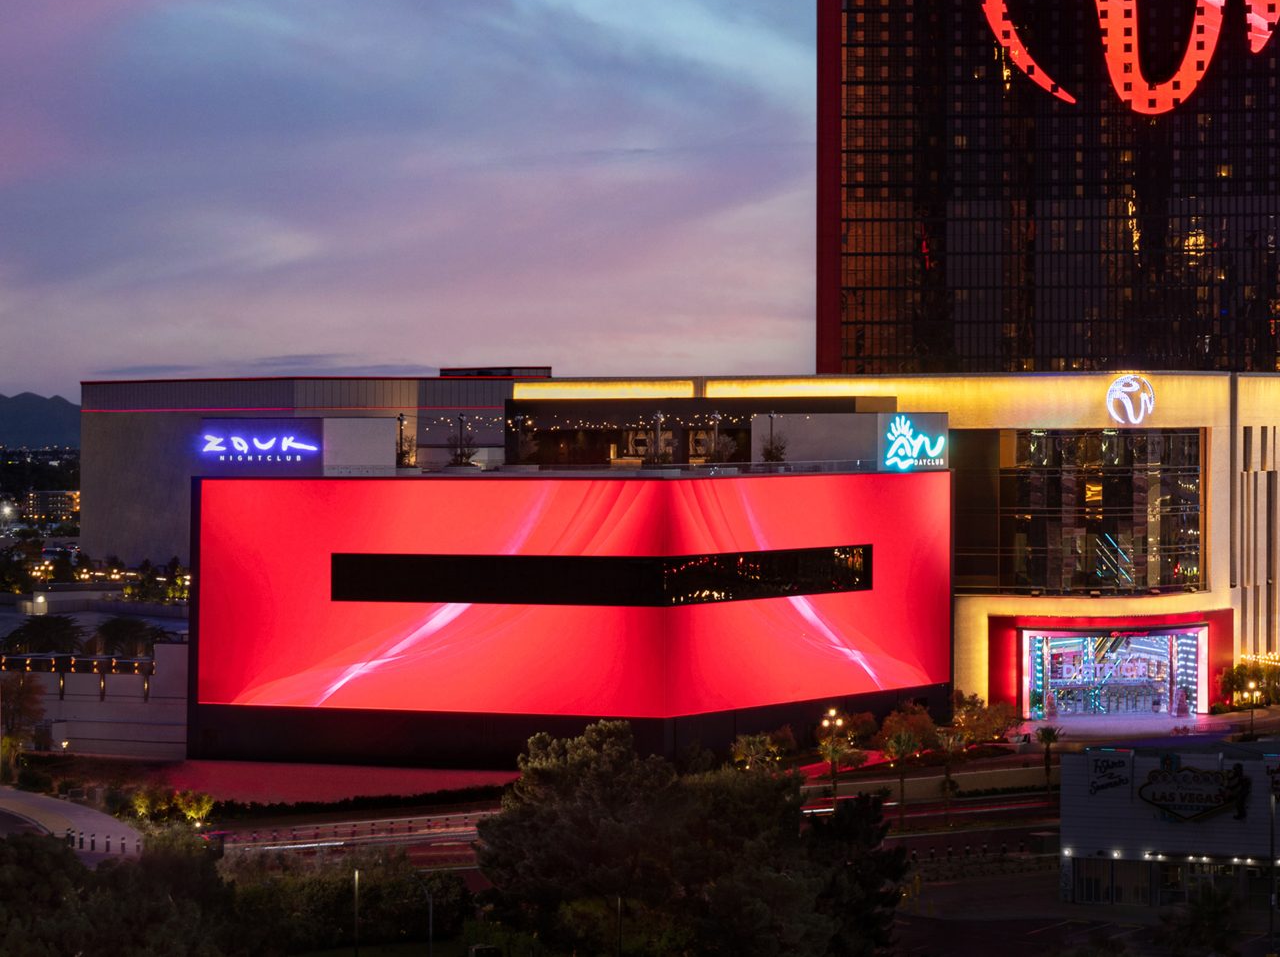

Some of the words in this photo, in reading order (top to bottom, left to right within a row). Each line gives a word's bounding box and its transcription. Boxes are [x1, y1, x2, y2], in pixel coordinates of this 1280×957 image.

[219, 454, 302, 462] NIGHTCLUB
[914, 458, 944, 466] DAYCLUB
[1152, 792, 1176, 802] LAS
[1179, 792, 1222, 803] VEGAS
